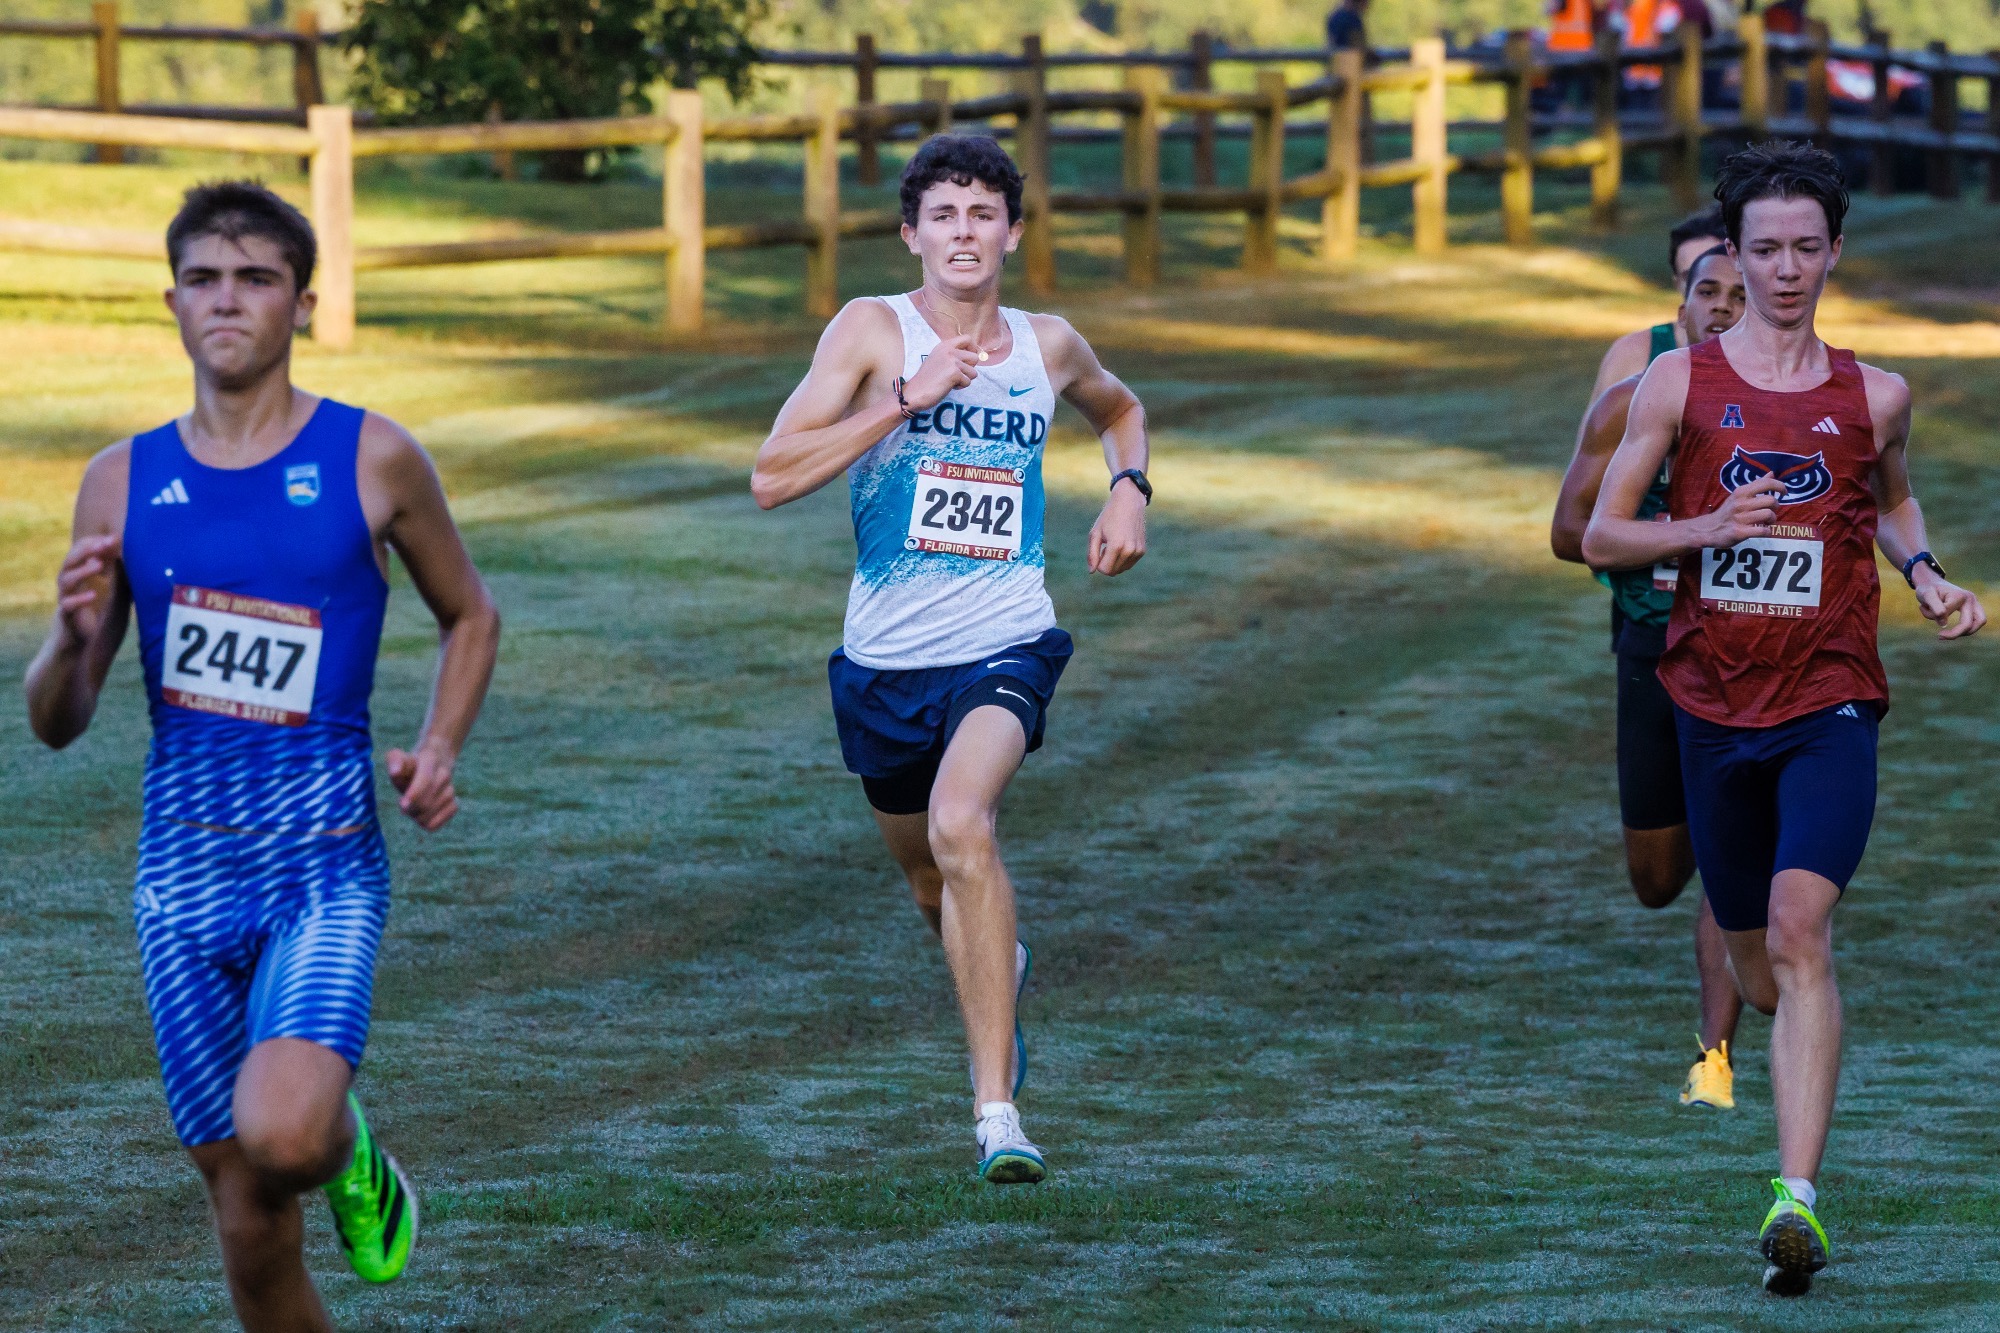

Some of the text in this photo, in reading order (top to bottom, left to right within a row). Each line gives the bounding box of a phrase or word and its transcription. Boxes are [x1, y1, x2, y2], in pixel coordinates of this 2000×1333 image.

[908, 402, 1045, 447] ECKERD
[947, 466, 1015, 484] FSU INVITATIONAL
[921, 487, 1015, 537] 2342
[1753, 524, 1815, 538] TATIONAL
[924, 540, 1005, 559] FLORIDA STATE
[1711, 547, 1812, 593] 2372
[1717, 601, 1802, 617] FLORIDA STATE
[176, 622, 306, 691] 2447
[179, 693, 287, 724] FLORIDA STATE
